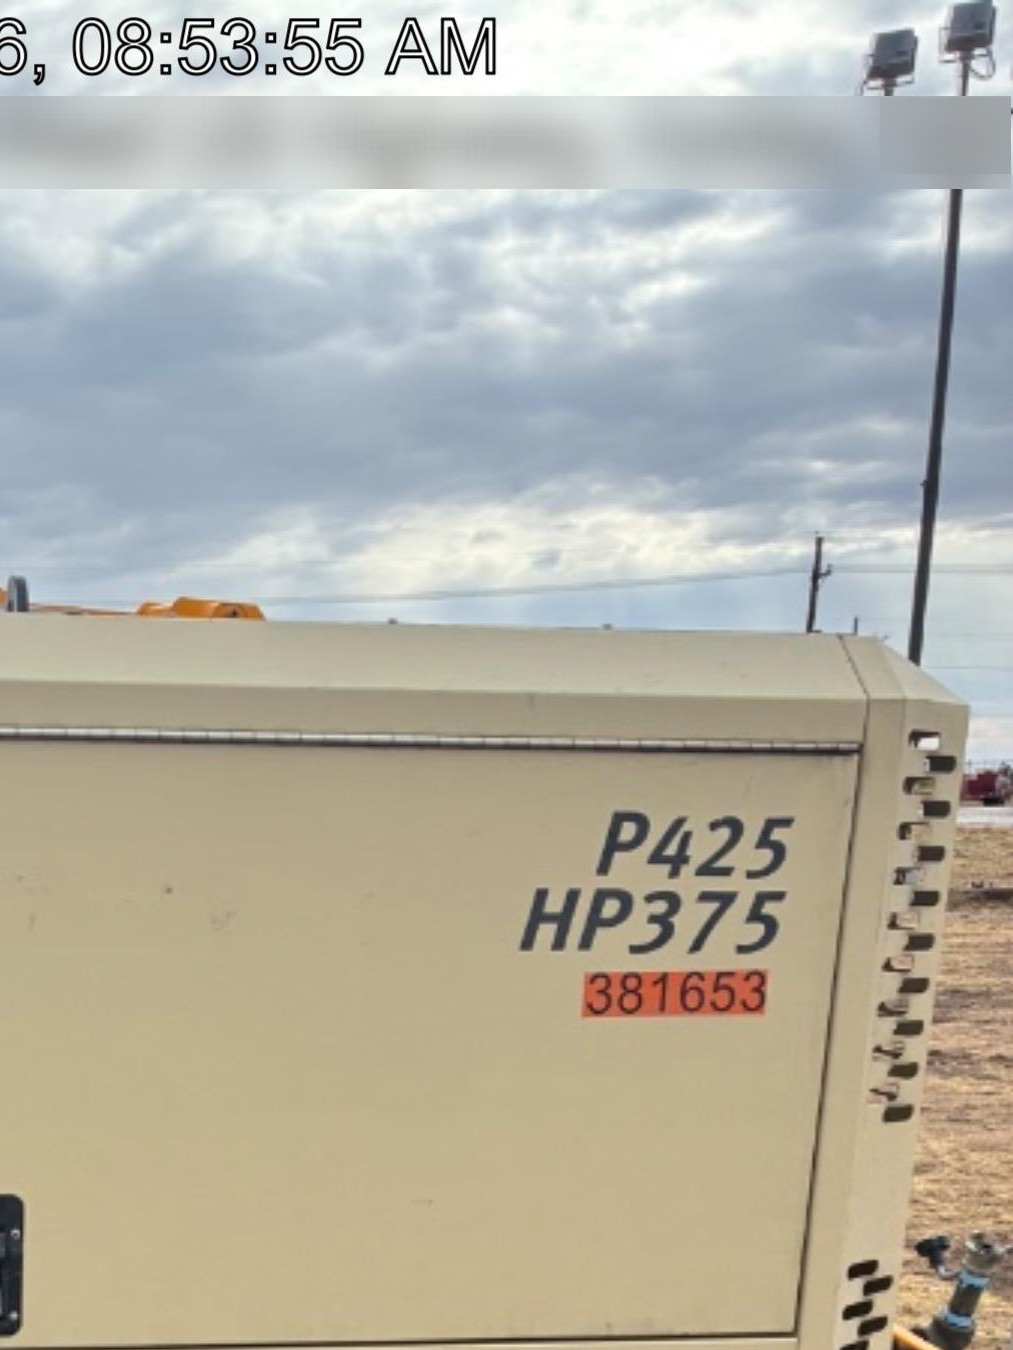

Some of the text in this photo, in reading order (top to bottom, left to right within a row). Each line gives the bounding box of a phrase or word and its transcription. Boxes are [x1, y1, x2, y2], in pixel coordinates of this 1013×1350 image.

[596, 811, 795, 880] P425
[519, 888, 788, 955] HP375
[587, 970, 767, 1016] 381653
